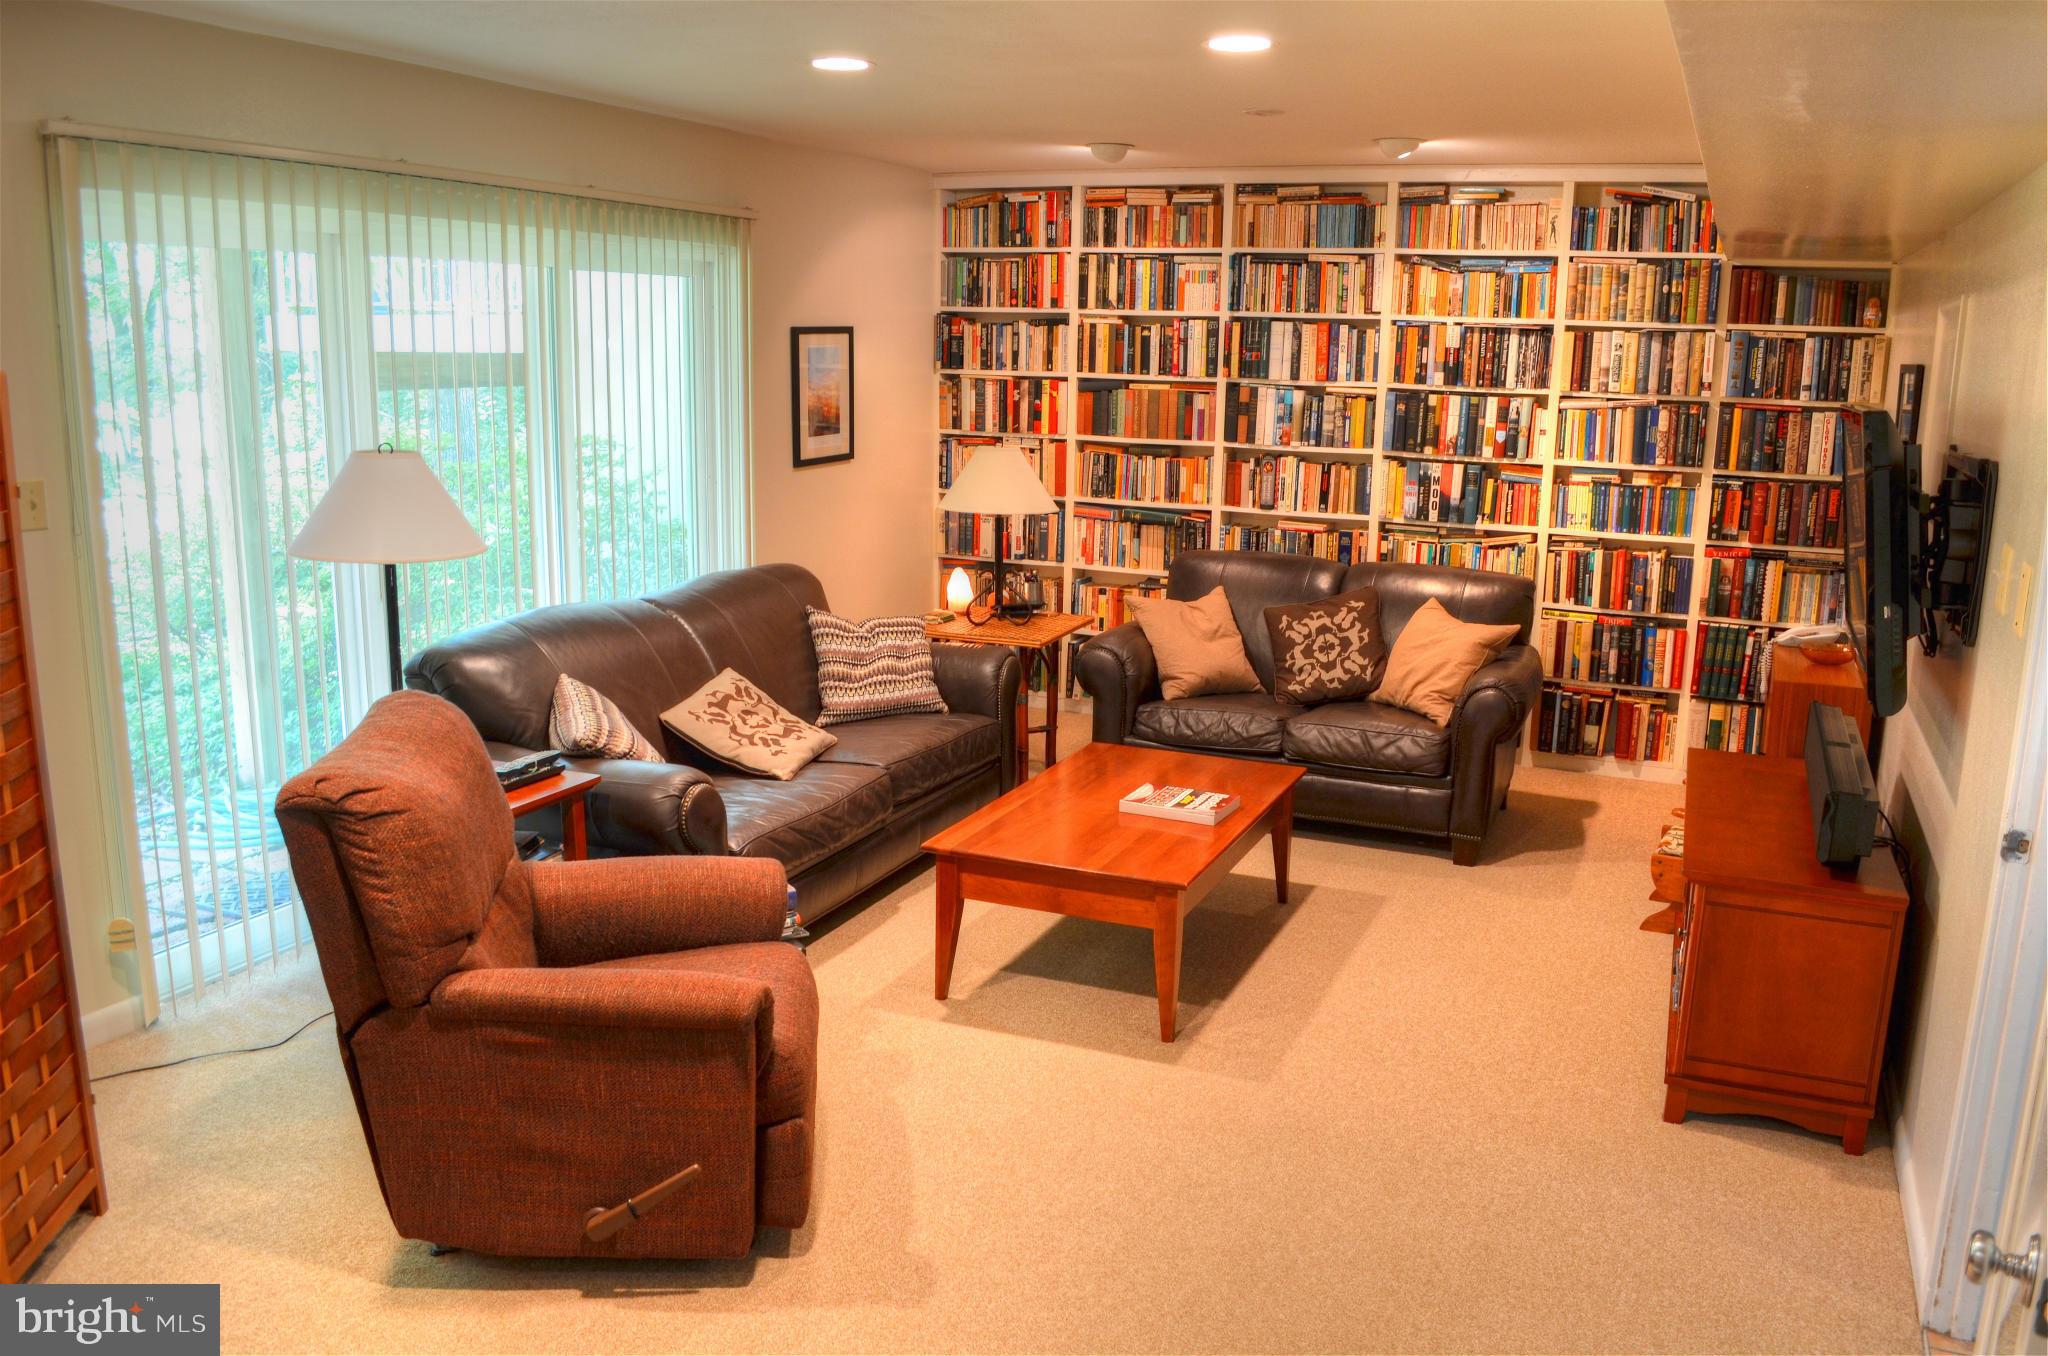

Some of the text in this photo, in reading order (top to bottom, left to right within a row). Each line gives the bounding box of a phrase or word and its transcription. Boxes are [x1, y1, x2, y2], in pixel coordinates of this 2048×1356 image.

[1754, 358, 1763, 389] ENCYCLOPEDIA
[1431, 475, 1440, 511] MOO
[1757, 562, 1765, 594] JERUSALEM
